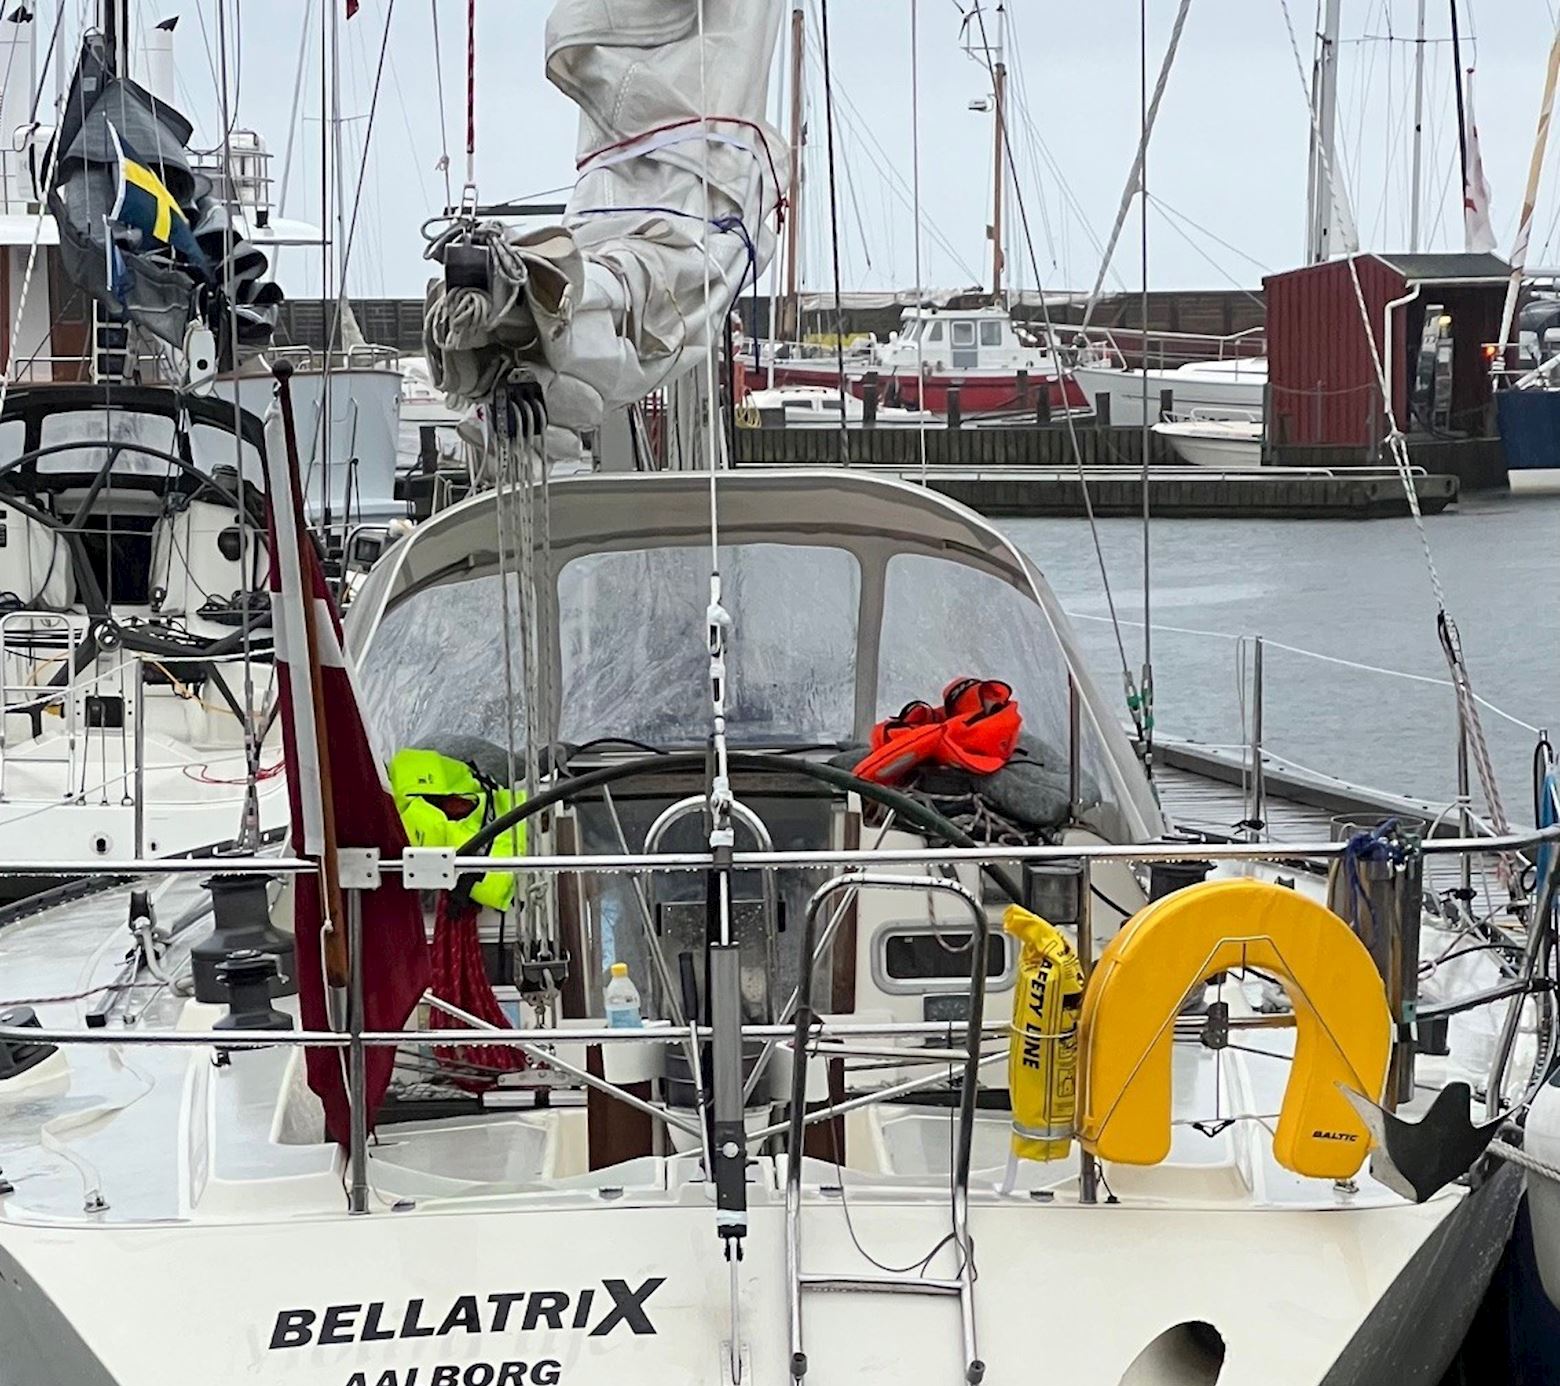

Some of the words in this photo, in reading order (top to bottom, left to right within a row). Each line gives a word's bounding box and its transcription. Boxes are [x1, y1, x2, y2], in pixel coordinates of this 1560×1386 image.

[1029, 957, 1054, 1018] AFETY
[1312, 1130, 1358, 1142] BALTIC
[268, 1277, 667, 1350] BELLATRIX
